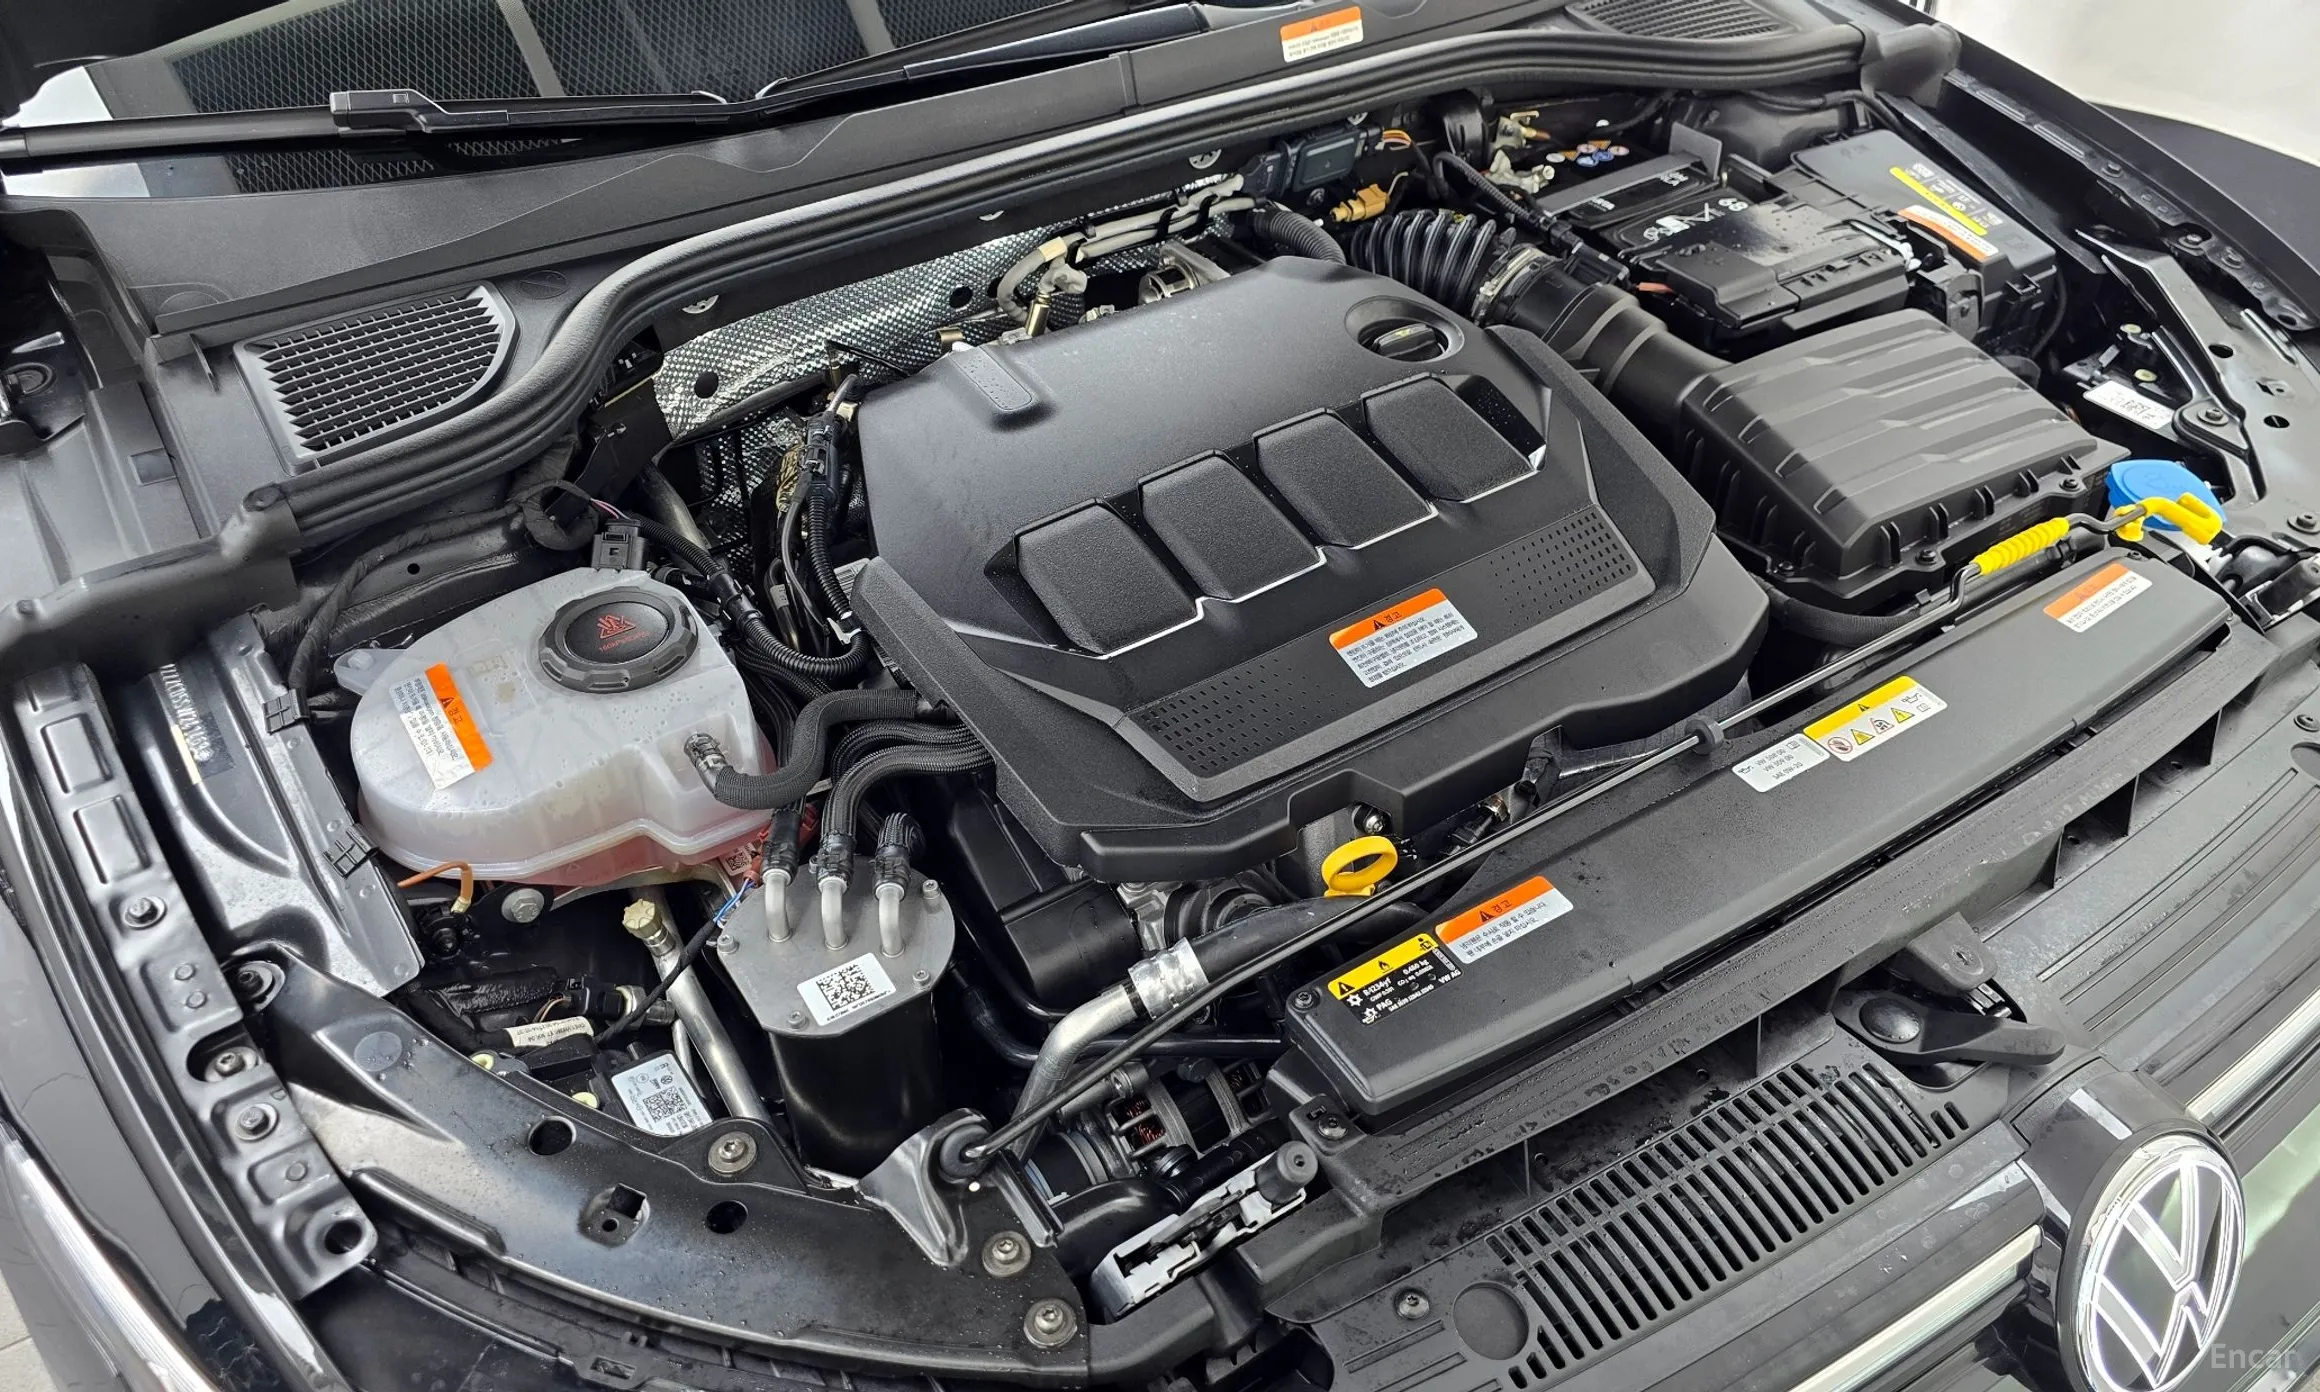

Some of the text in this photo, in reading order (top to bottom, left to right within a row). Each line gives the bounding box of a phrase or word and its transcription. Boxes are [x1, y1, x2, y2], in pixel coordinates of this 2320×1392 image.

[1384, 611, 1401, 622] 경고
[448, 707, 462, 723] 경고
[1492, 900, 1510, 912] 경고
[1439, 975, 1451, 983] VW
[1376, 999, 1392, 1009] PAG
